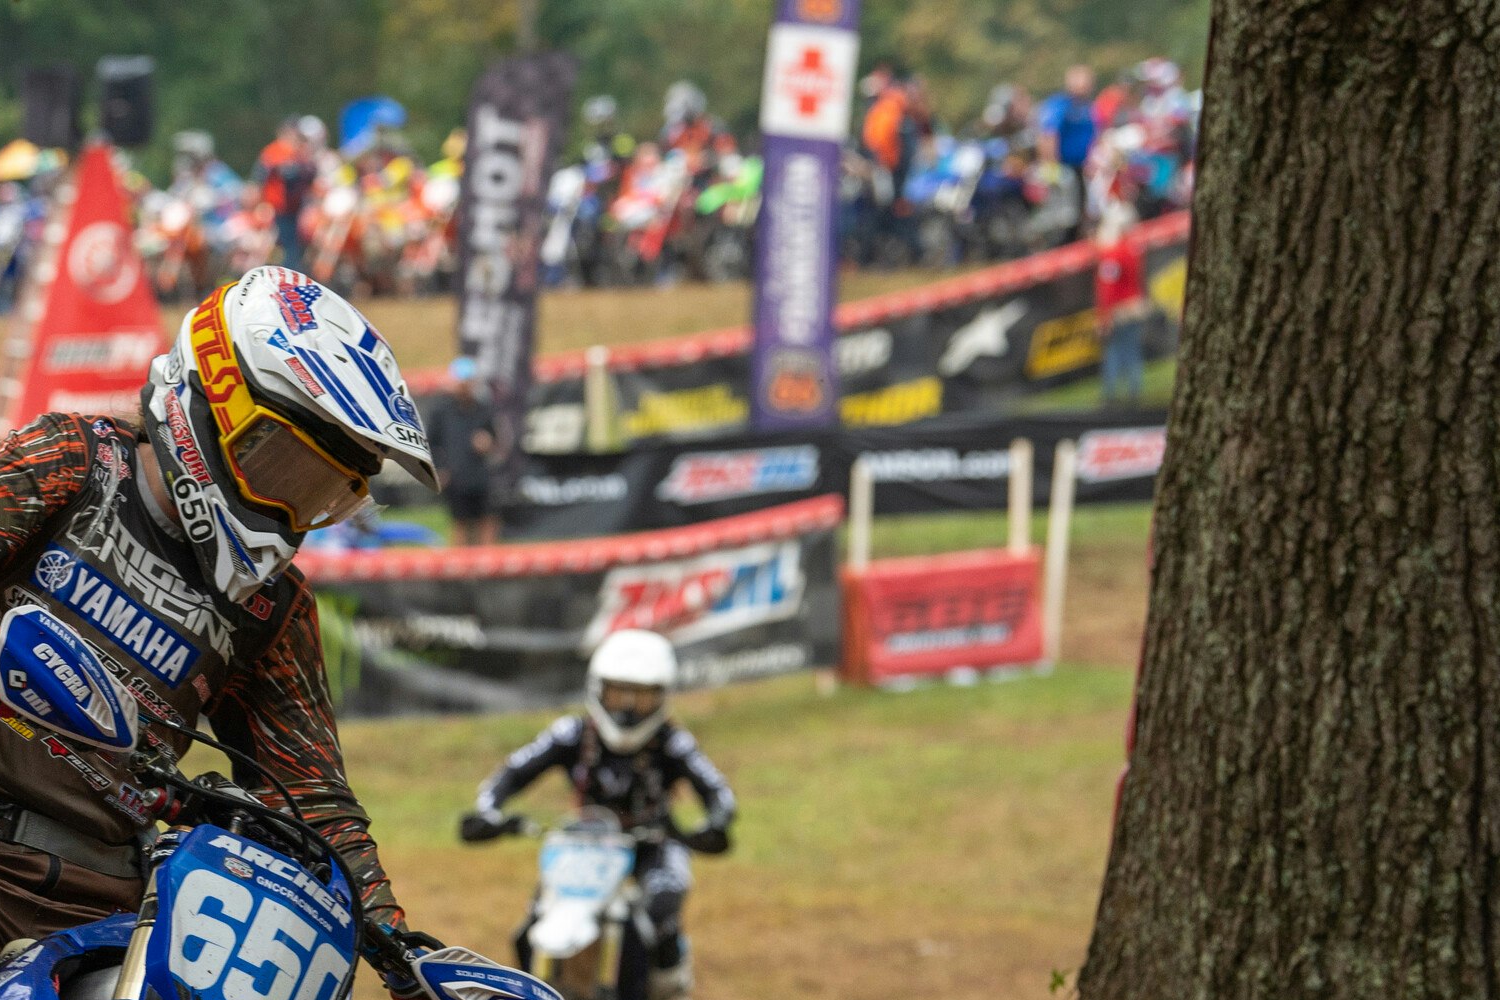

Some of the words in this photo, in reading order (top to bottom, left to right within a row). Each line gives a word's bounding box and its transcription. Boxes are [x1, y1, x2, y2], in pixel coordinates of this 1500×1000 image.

[175, 479, 213, 541] 650
[39, 613, 76, 650] YAMAHA
[69, 567, 190, 682] YAMAHA
[32, 642, 92, 702] CYCRA
[208, 834, 353, 930] ARCHER
